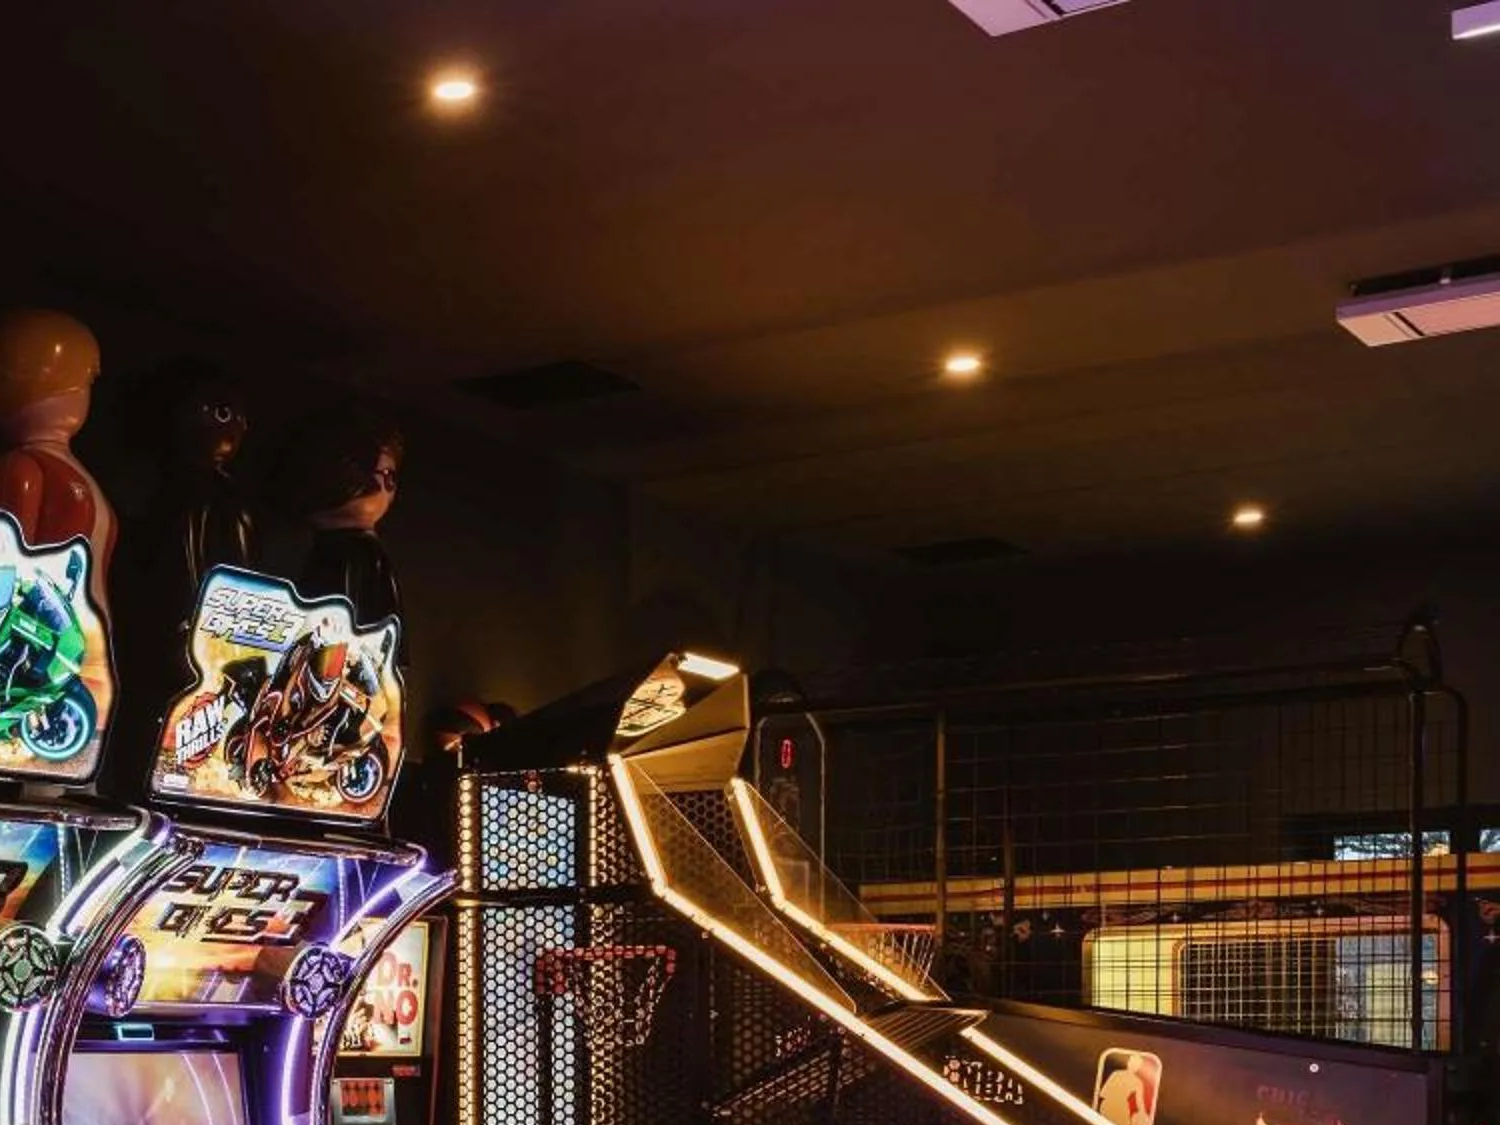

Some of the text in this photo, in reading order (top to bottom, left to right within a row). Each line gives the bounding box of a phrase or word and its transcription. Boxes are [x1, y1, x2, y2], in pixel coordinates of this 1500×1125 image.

[203, 587, 289, 622] SUPER
[199, 610, 276, 639] BIKES
[176, 695, 225, 750] RAW
[176, 724, 225, 765] THRILLS
[161, 865, 300, 903] SUPER
